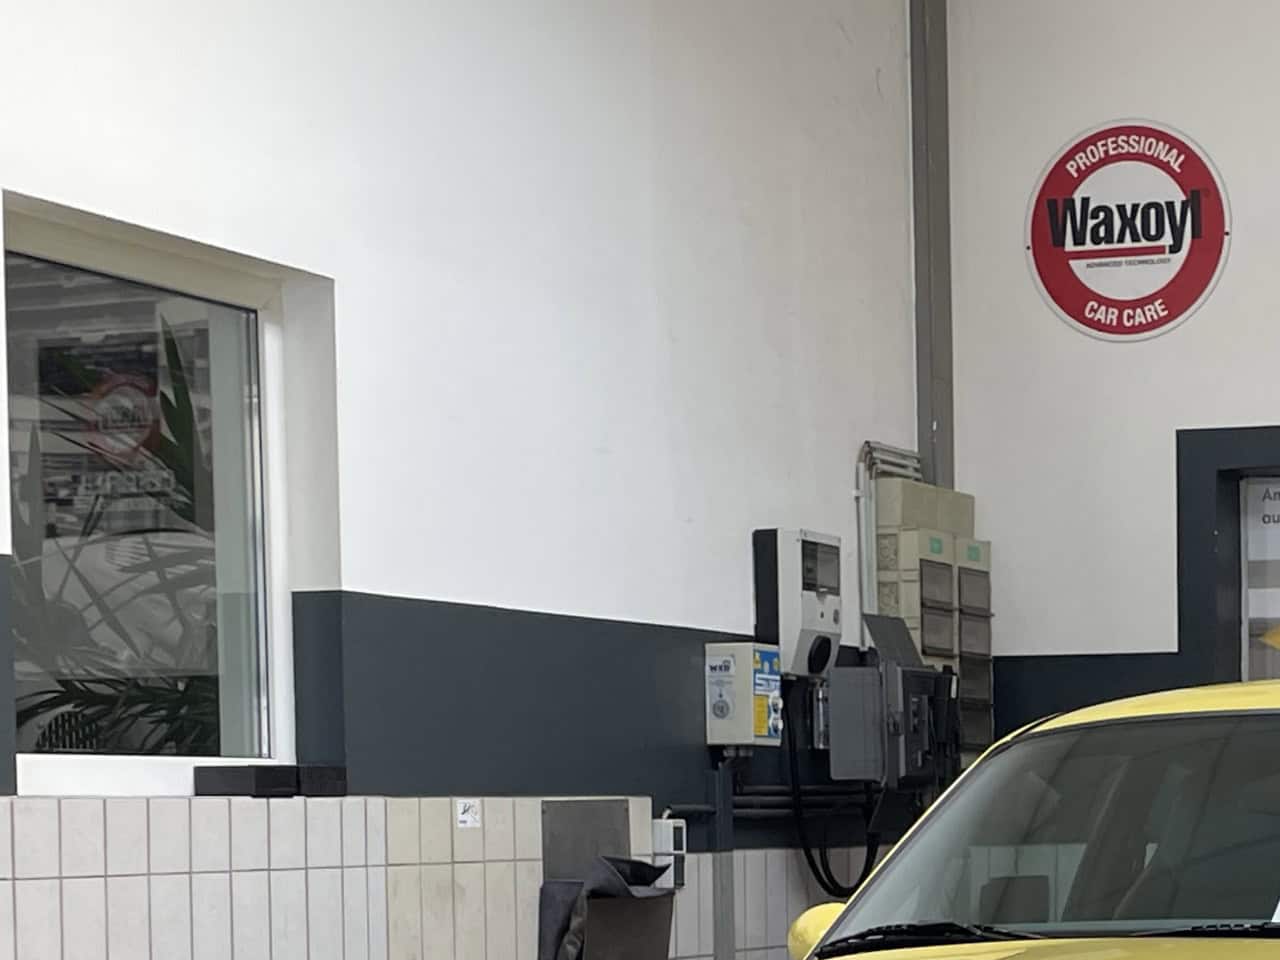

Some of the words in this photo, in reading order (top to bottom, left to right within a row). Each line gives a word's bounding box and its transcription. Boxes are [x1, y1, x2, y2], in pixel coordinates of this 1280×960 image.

[1066, 135, 1186, 178] PROFESSIONAL
[1047, 188, 1203, 254] Waxoyl
[1084, 301, 1118, 326] CAR
[1123, 299, 1168, 327] CARE
